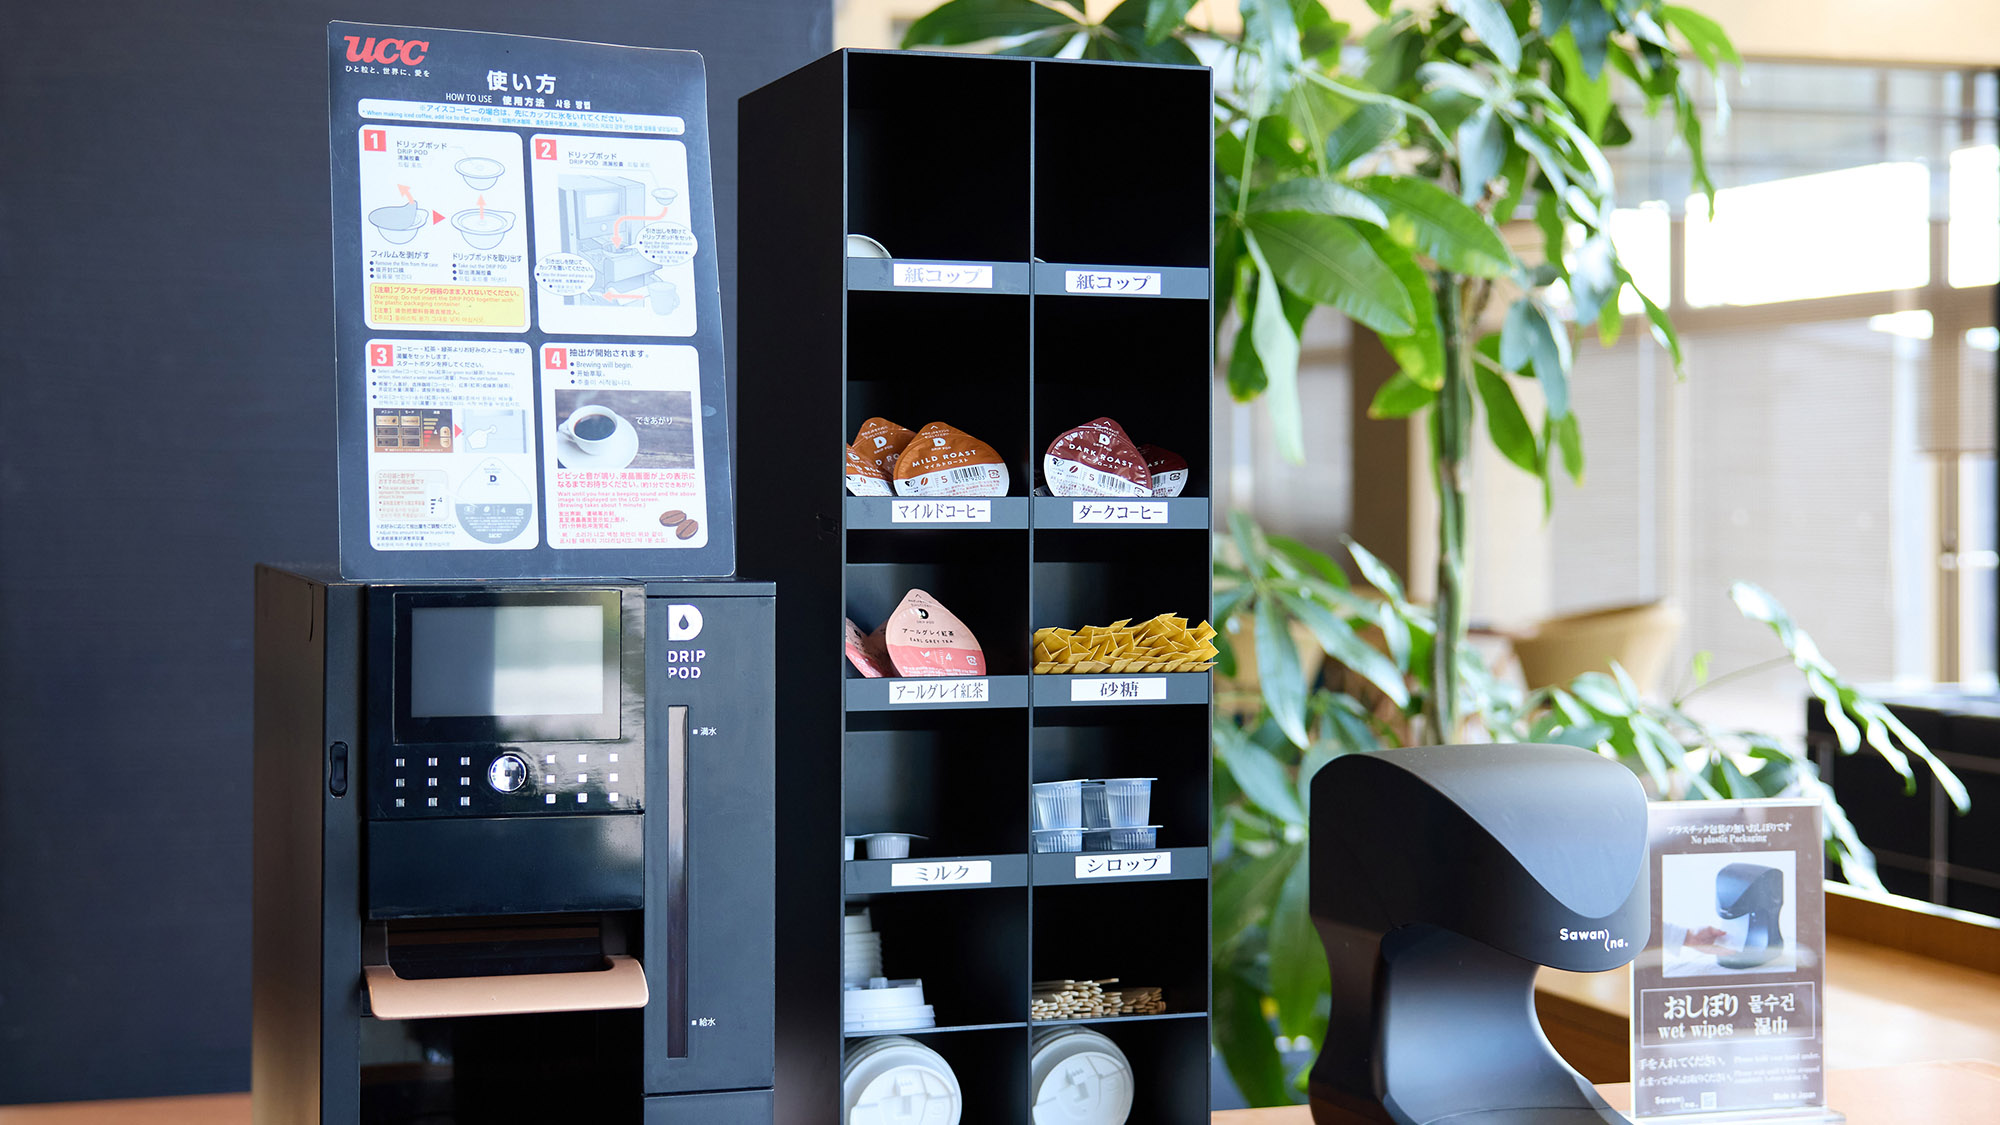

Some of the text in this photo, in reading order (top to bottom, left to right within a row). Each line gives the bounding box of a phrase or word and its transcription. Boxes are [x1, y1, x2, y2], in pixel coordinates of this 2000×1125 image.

[486, 69, 557, 95] 使い方
[445, 92, 492, 103] HOW TO USE
[502, 95, 545, 108] 使用方法
[371, 133, 378, 149] 1
[541, 142, 551, 158] 2
[905, 266, 983, 285] 紙コップ
[1076, 273, 1152, 291] 紙コップ
[377, 348, 387, 364] 3
[552, 351, 561, 367] 4
[576, 361, 601, 370] Brewing
[912, 455, 938, 468] MILD
[942, 449, 977, 460] ROAST
[1069, 443, 1133, 468] DARK ROAST
[1147, 459, 1165, 468] AST
[941, 475, 948, 484] 5
[898, 503, 986, 520] マイルドコーヒー
[1079, 504, 1163, 520] ダークコーヒー
[667, 649, 706, 663] DRIP
[667, 666, 702, 679] POD
[896, 683, 984, 700] アールグレイ紅茶
[1100, 681, 1140, 698] 砂糖
[1691, 835, 1702, 845] No
[1703, 834, 1728, 845] plastic
[914, 863, 970, 881] ミルク
[1087, 854, 1162, 876] シロップ
[1663, 992, 1739, 1020] おしぼり
[1748, 992, 1796, 1014] 물수건
[1657, 1020, 1734, 1040] wet wipes
